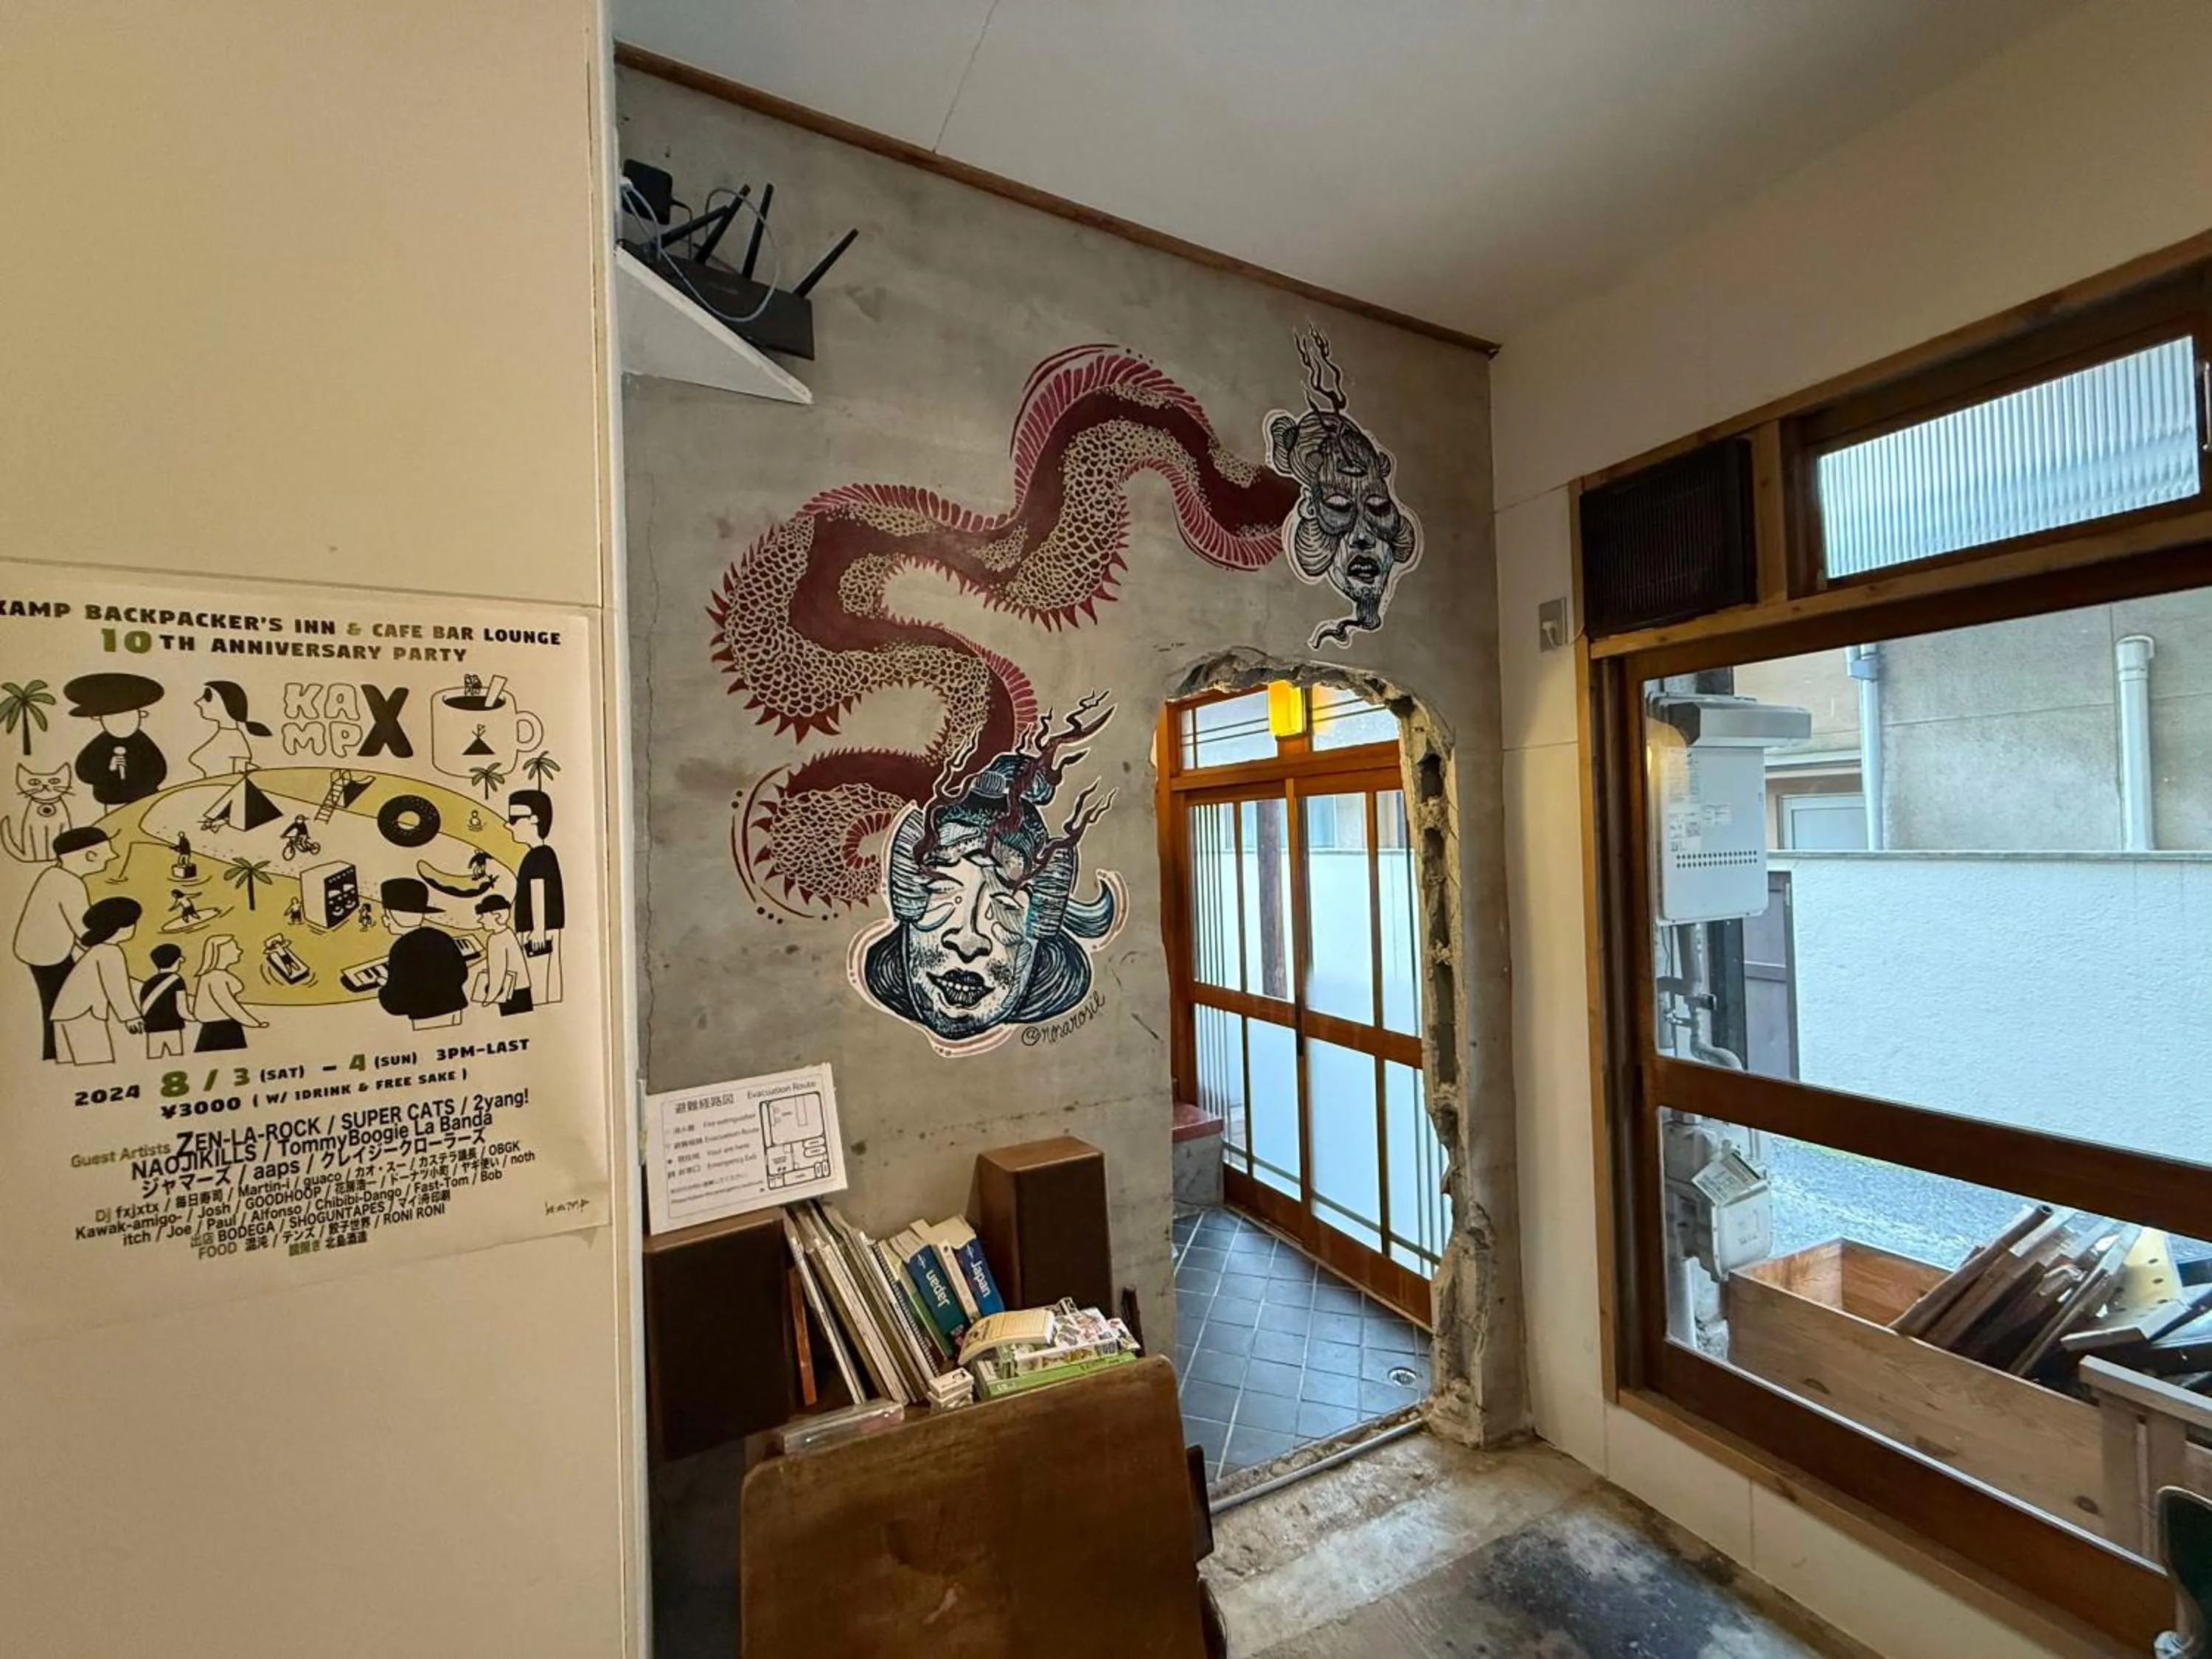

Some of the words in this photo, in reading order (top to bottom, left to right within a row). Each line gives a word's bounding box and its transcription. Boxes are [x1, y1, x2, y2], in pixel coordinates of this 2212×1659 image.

[85, 604, 284, 632] BACKPACKER'S
[294, 619, 335, 636] INN
[346, 622, 362, 636] &
[372, 624, 423, 639] CAFE
[433, 626, 474, 641] BAR
[484, 628, 562, 645] LOUNGE
[211, 636, 382, 661] ANNIVERSARY
[393, 647, 467, 662] PARTY
[74, 1085, 140, 1106] 2024
[233, 1067, 251, 1087] 3
[260, 1065, 305, 1083] (SAT)
[349, 1054, 366, 1071] 4
[374, 1051, 417, 1069] (SUN)
[436, 1038, 529, 1061] 3PM-LAST
[160, 1096, 242, 1120] ¥3000
[358, 1082, 369, 1092] &
[376, 1076, 412, 1091] FREE
[418, 1071, 456, 1085] SAKE
[341, 1106, 403, 1130] SUPER
[407, 1099, 455, 1121] CATS
[473, 1088, 529, 1113] 2yang!
[71, 1151, 116, 1168] Guest
[119, 1143, 172, 1161] Artists
[131, 1144, 257, 1180] NAOJIKILLS
[277, 1123, 408, 1157] TommyBoogie
[414, 1120, 434, 1136] La
[440, 1111, 493, 1133] Banda
[253, 1160, 301, 1180] aaps
[123, 1230, 151, 1247] itch
[166, 1225, 192, 1238] Joe
[206, 1214, 236, 1231] Paul
[251, 1205, 302, 1223] Alfonso
[414, 1176, 469, 1194] Fast-Tom
[480, 1169, 502, 1183] Bob
[198, 1201, 231, 1218] Josh
[245, 1186, 321, 1210] GOODHOOP
[218, 1220, 275, 1242] BODEGA
[289, 1201, 385, 1230] SHOGUNTAPES
[198, 1241, 237, 1261] FOOD
[383, 1209, 413, 1226] RONI
[417, 1203, 445, 1220] RONI
[925, 1269, 950, 1307] Japan
[970, 1259, 991, 1298] Japan
